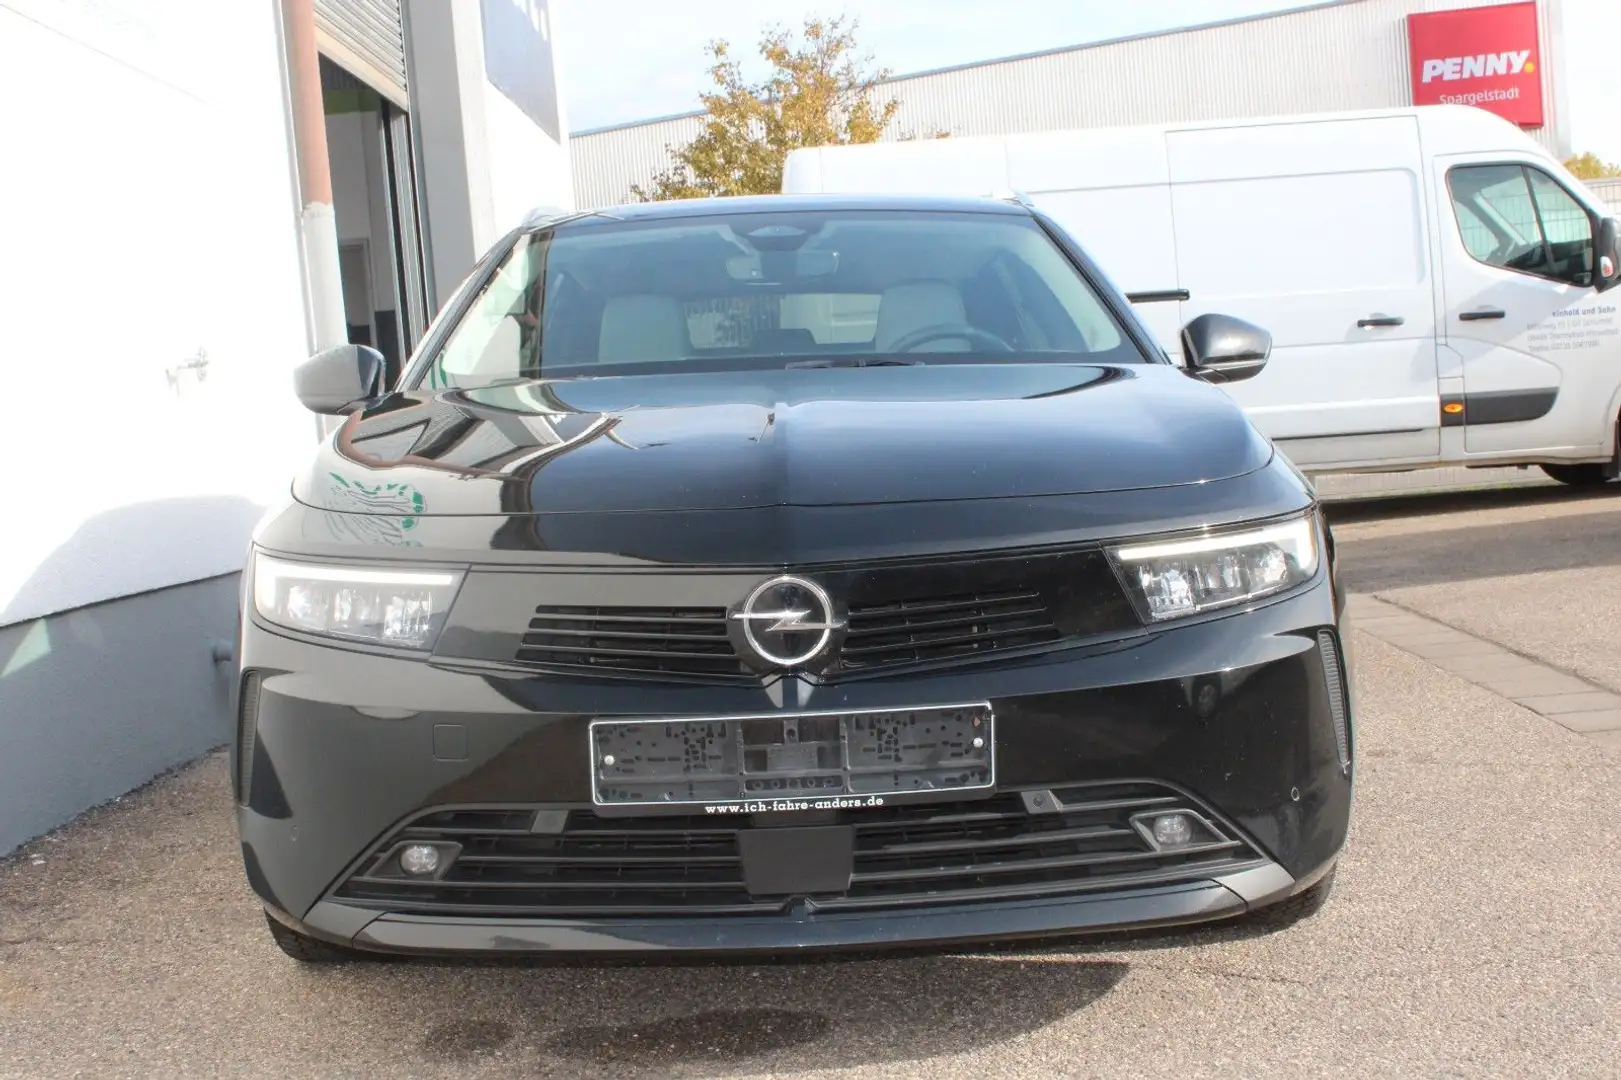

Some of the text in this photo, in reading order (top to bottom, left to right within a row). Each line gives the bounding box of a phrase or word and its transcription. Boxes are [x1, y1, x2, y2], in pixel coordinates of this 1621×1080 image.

[1439, 86, 1520, 105] Spargelstadt
[1582, 306, 1595, 316] und
[705, 796, 884, 814] www.ich-fahre-anders.de
